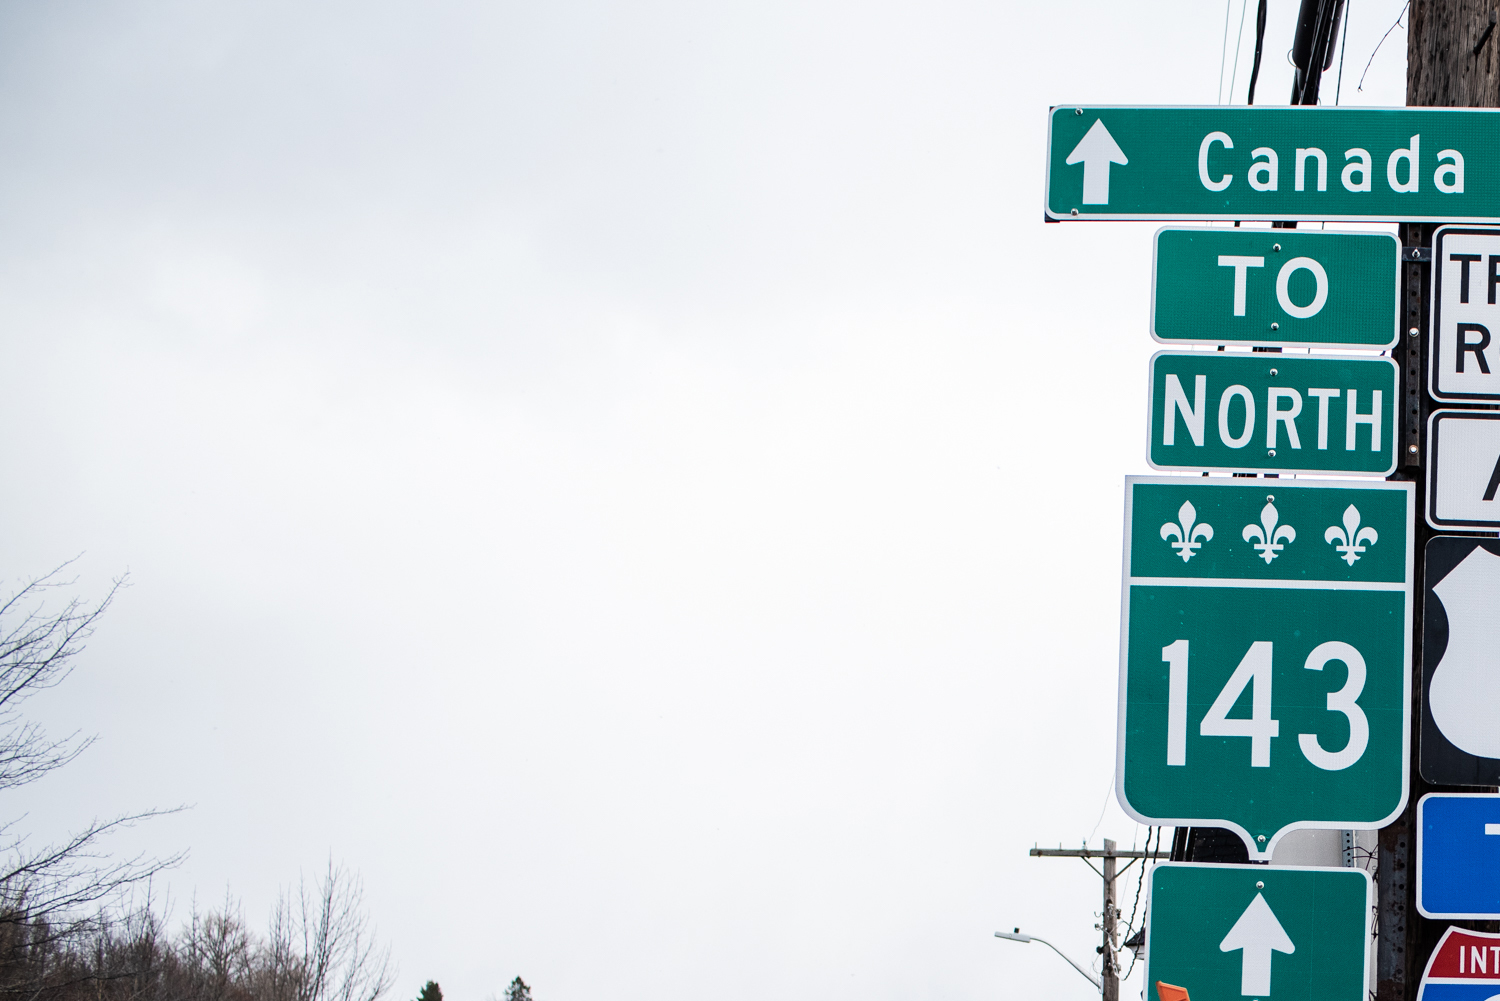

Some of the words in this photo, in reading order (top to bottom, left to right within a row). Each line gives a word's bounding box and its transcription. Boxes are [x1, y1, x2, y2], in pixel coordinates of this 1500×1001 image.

[1198, 131, 1465, 194] Canada
[1217, 255, 1329, 319] TO
[1162, 373, 1383, 452] NORTH
[1161, 639, 1370, 771] 143
